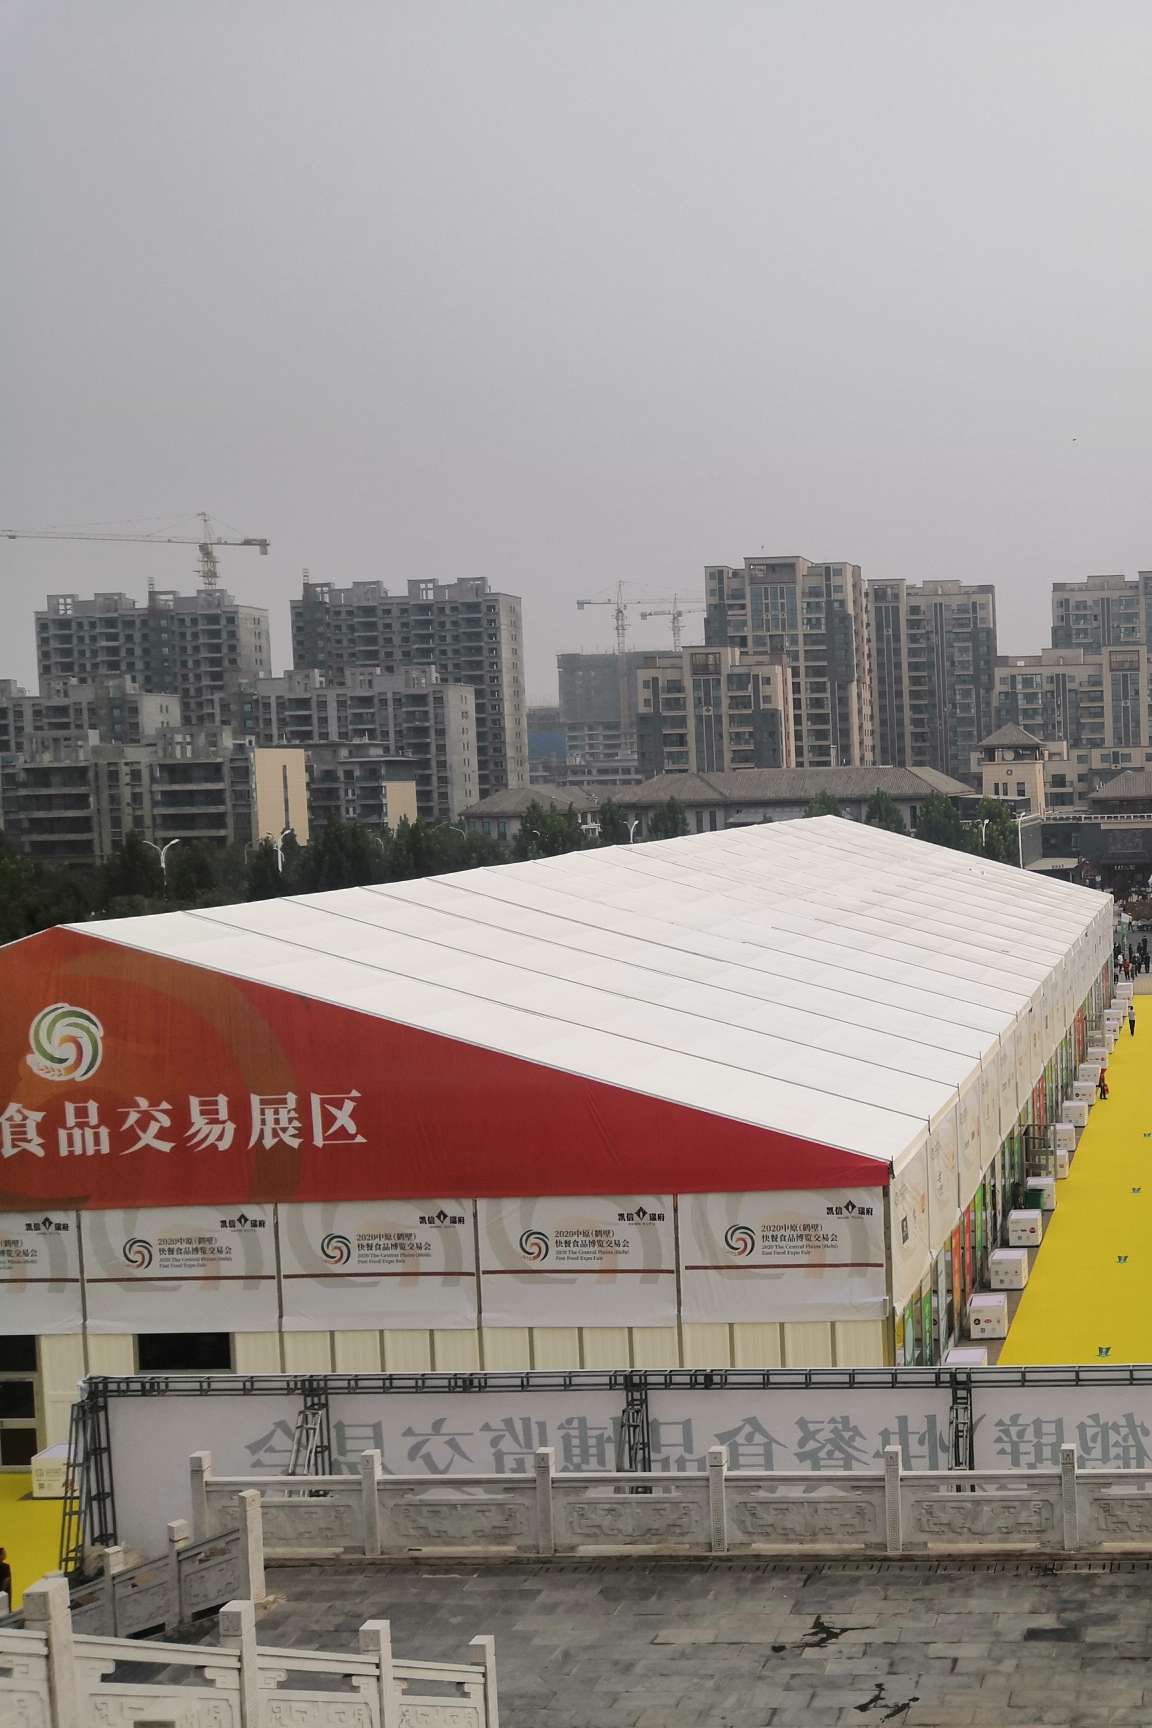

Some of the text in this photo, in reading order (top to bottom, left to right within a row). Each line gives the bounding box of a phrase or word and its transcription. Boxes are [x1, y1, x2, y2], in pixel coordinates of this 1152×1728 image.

[0, 1089, 367, 1159] 食品交易展区
